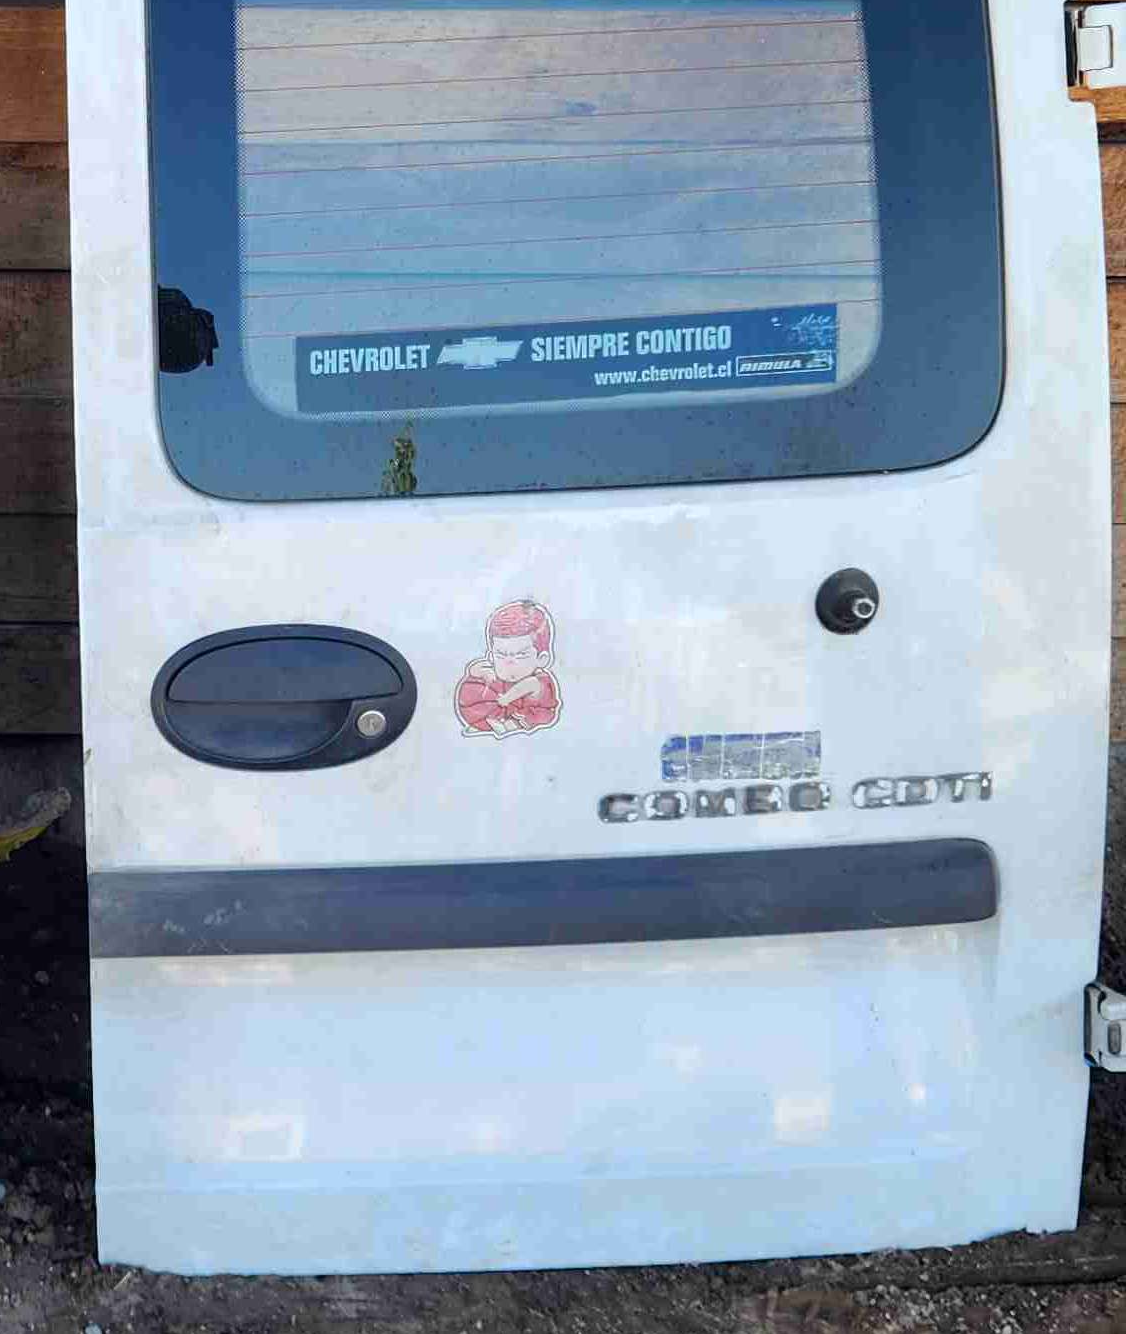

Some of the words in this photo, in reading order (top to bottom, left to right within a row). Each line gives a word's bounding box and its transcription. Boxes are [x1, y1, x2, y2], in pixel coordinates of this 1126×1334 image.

[310, 344, 430, 375] CHEVROLET
[531, 332, 629, 362] SIEMPRE
[636, 325, 732, 355] CONTIGO
[594, 361, 732, 386] www.chevrolet.cl
[597, 781, 831, 823] COMBO
[852, 771, 994, 808] CDTI
